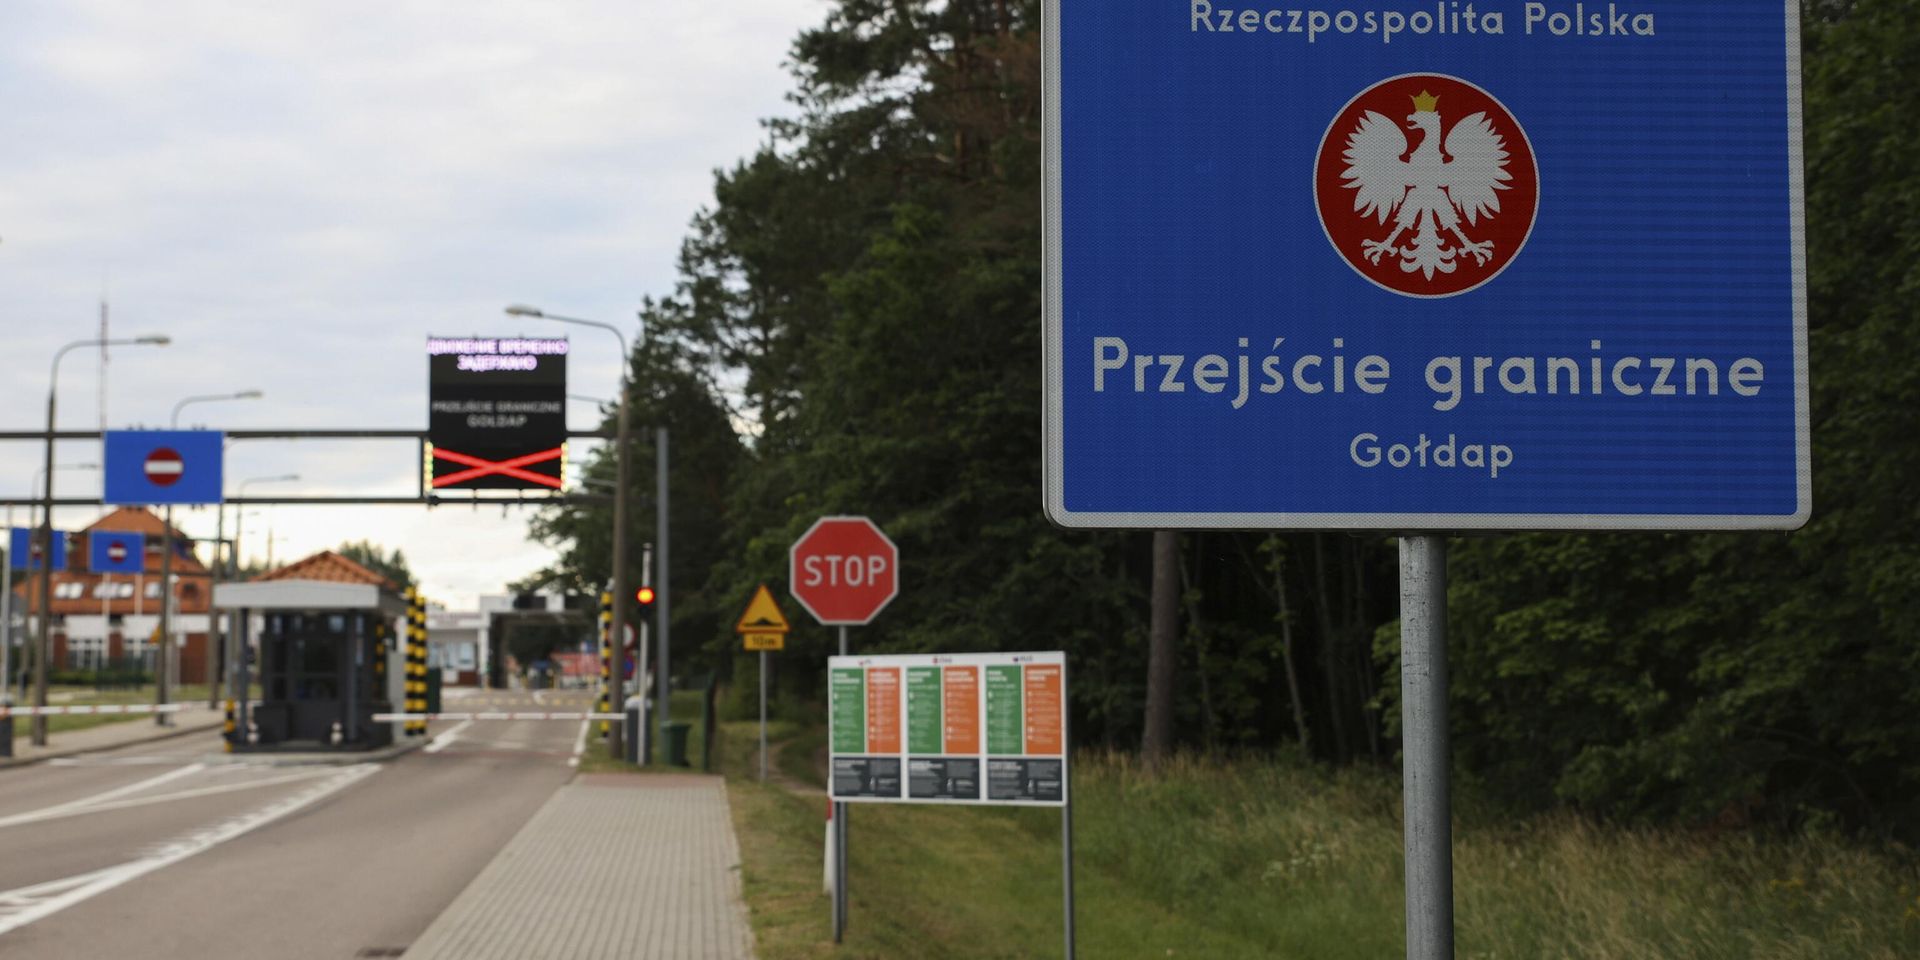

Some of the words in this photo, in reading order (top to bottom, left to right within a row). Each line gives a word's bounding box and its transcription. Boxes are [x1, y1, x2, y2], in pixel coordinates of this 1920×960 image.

[1191, 0, 1504, 43] Rzeczpospolita
[1525, 2, 1655, 36] Polska
[1092, 336, 1391, 410] Przejście
[1424, 339, 1765, 411] graniczne
[1350, 432, 1513, 478] Gołdap
[804, 555, 886, 586] STOP
